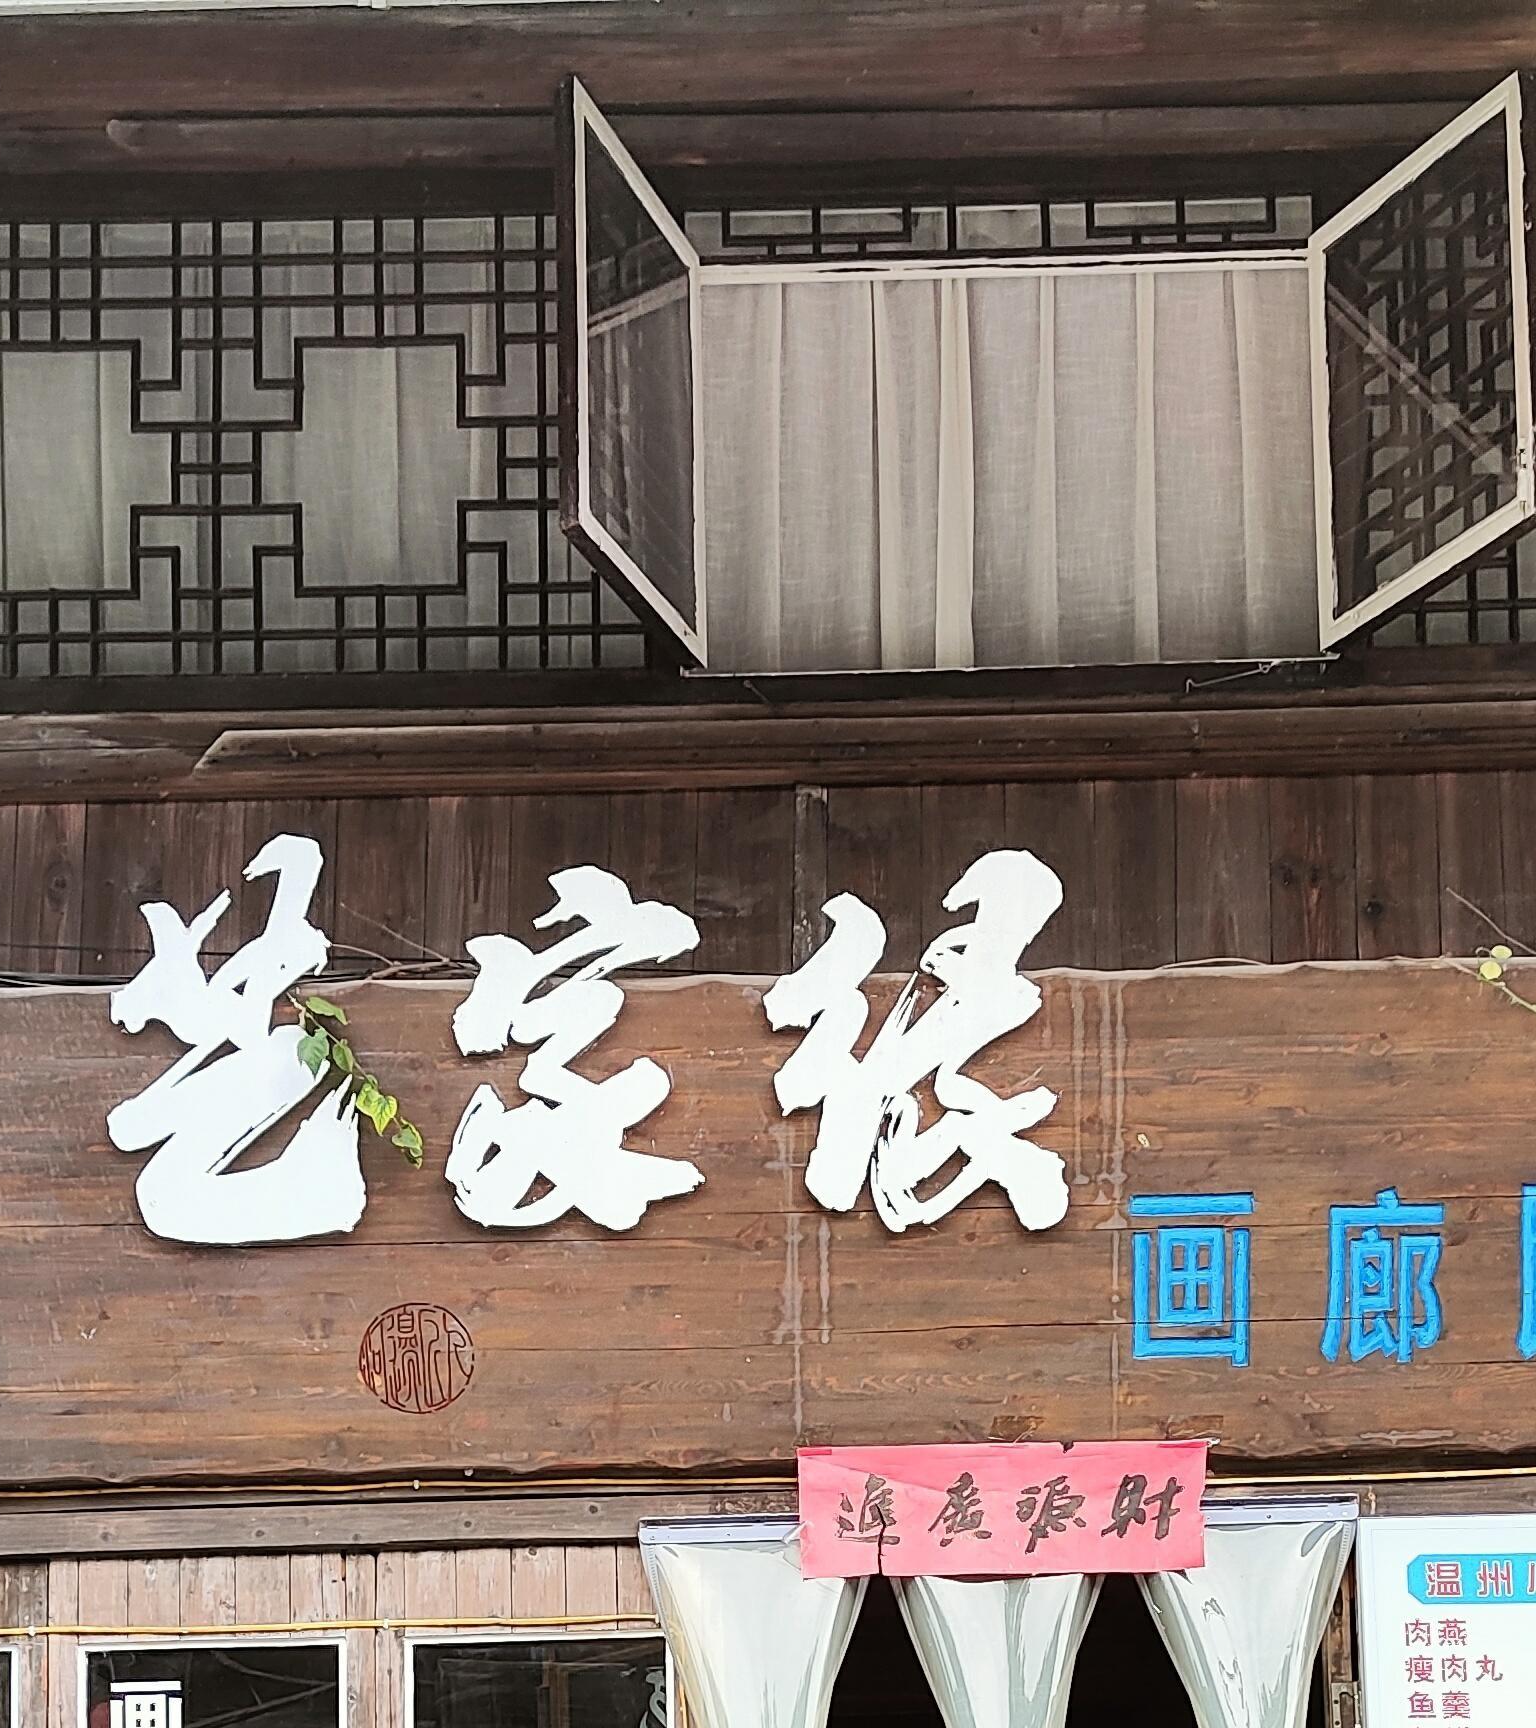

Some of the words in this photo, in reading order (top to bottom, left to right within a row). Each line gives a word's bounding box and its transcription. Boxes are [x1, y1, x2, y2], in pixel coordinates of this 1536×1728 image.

[1404, 1618, 1468, 1648] 肉燕
[1405, 1654, 1504, 1684] 瘦肉丸
[1407, 1690, 1472, 1720] 鱼羹
